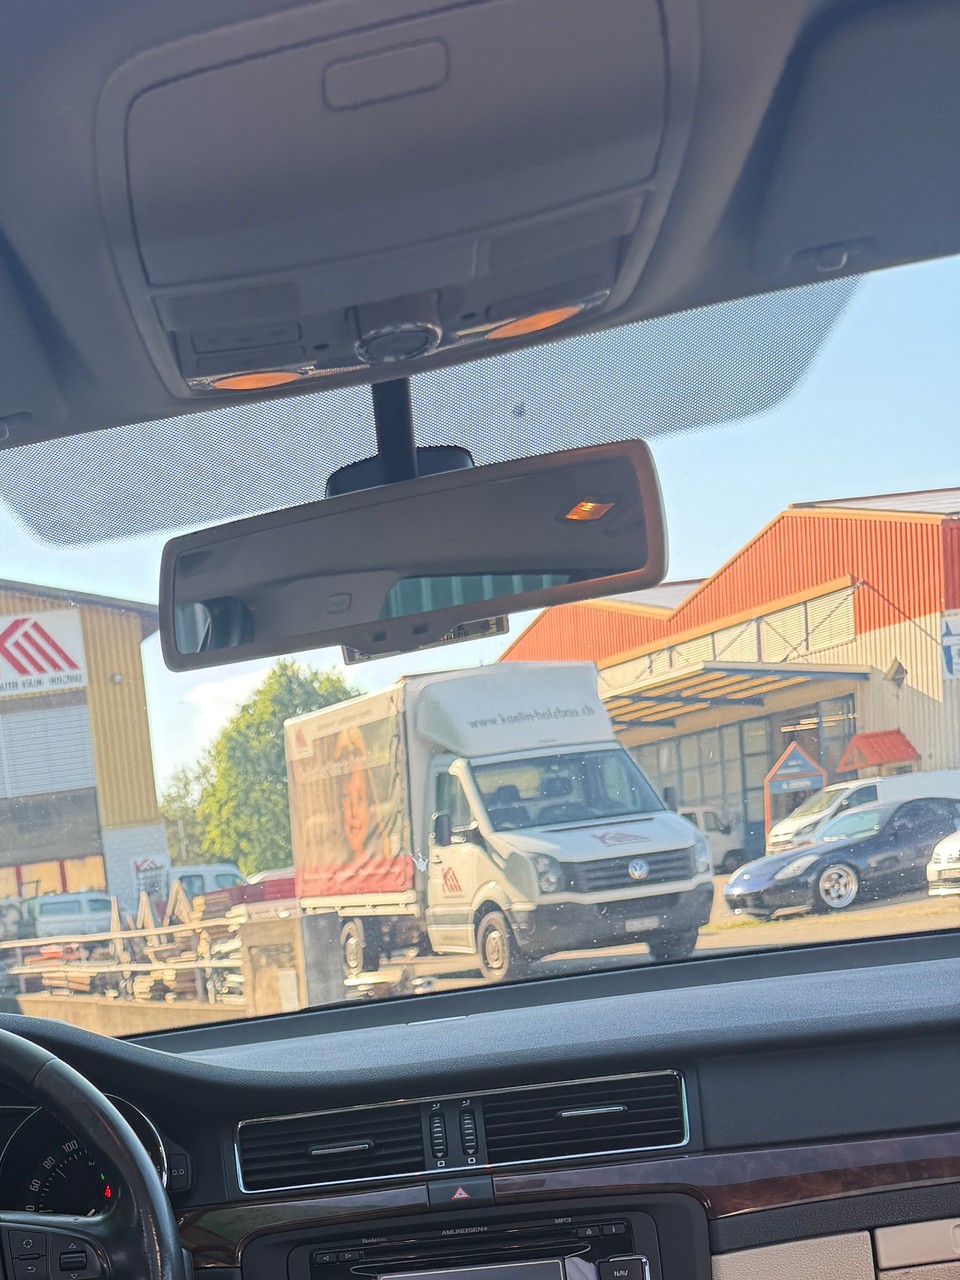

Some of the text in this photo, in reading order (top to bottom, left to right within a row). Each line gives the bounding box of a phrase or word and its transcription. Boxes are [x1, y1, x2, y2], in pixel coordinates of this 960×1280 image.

[62, 1139, 79, 1153] 100
[42, 1156, 56, 1169] 80
[29, 1179, 41, 1192] 60
